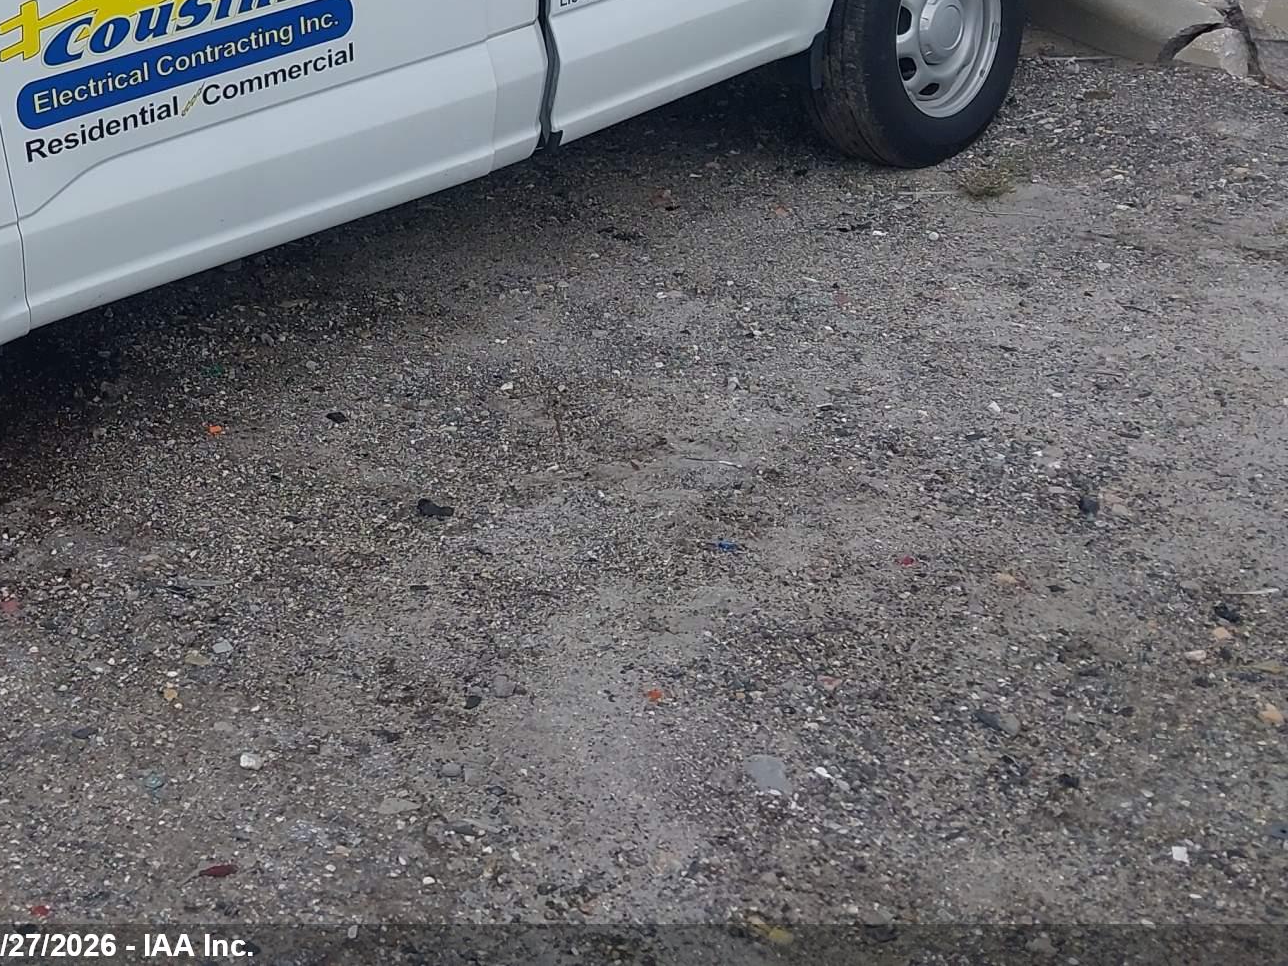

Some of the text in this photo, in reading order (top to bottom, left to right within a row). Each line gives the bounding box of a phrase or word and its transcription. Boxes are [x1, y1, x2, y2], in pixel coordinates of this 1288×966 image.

[25, 42, 355, 163] Residential Commercial
[33, 9, 339, 114] Electrical Contracting Inc.
